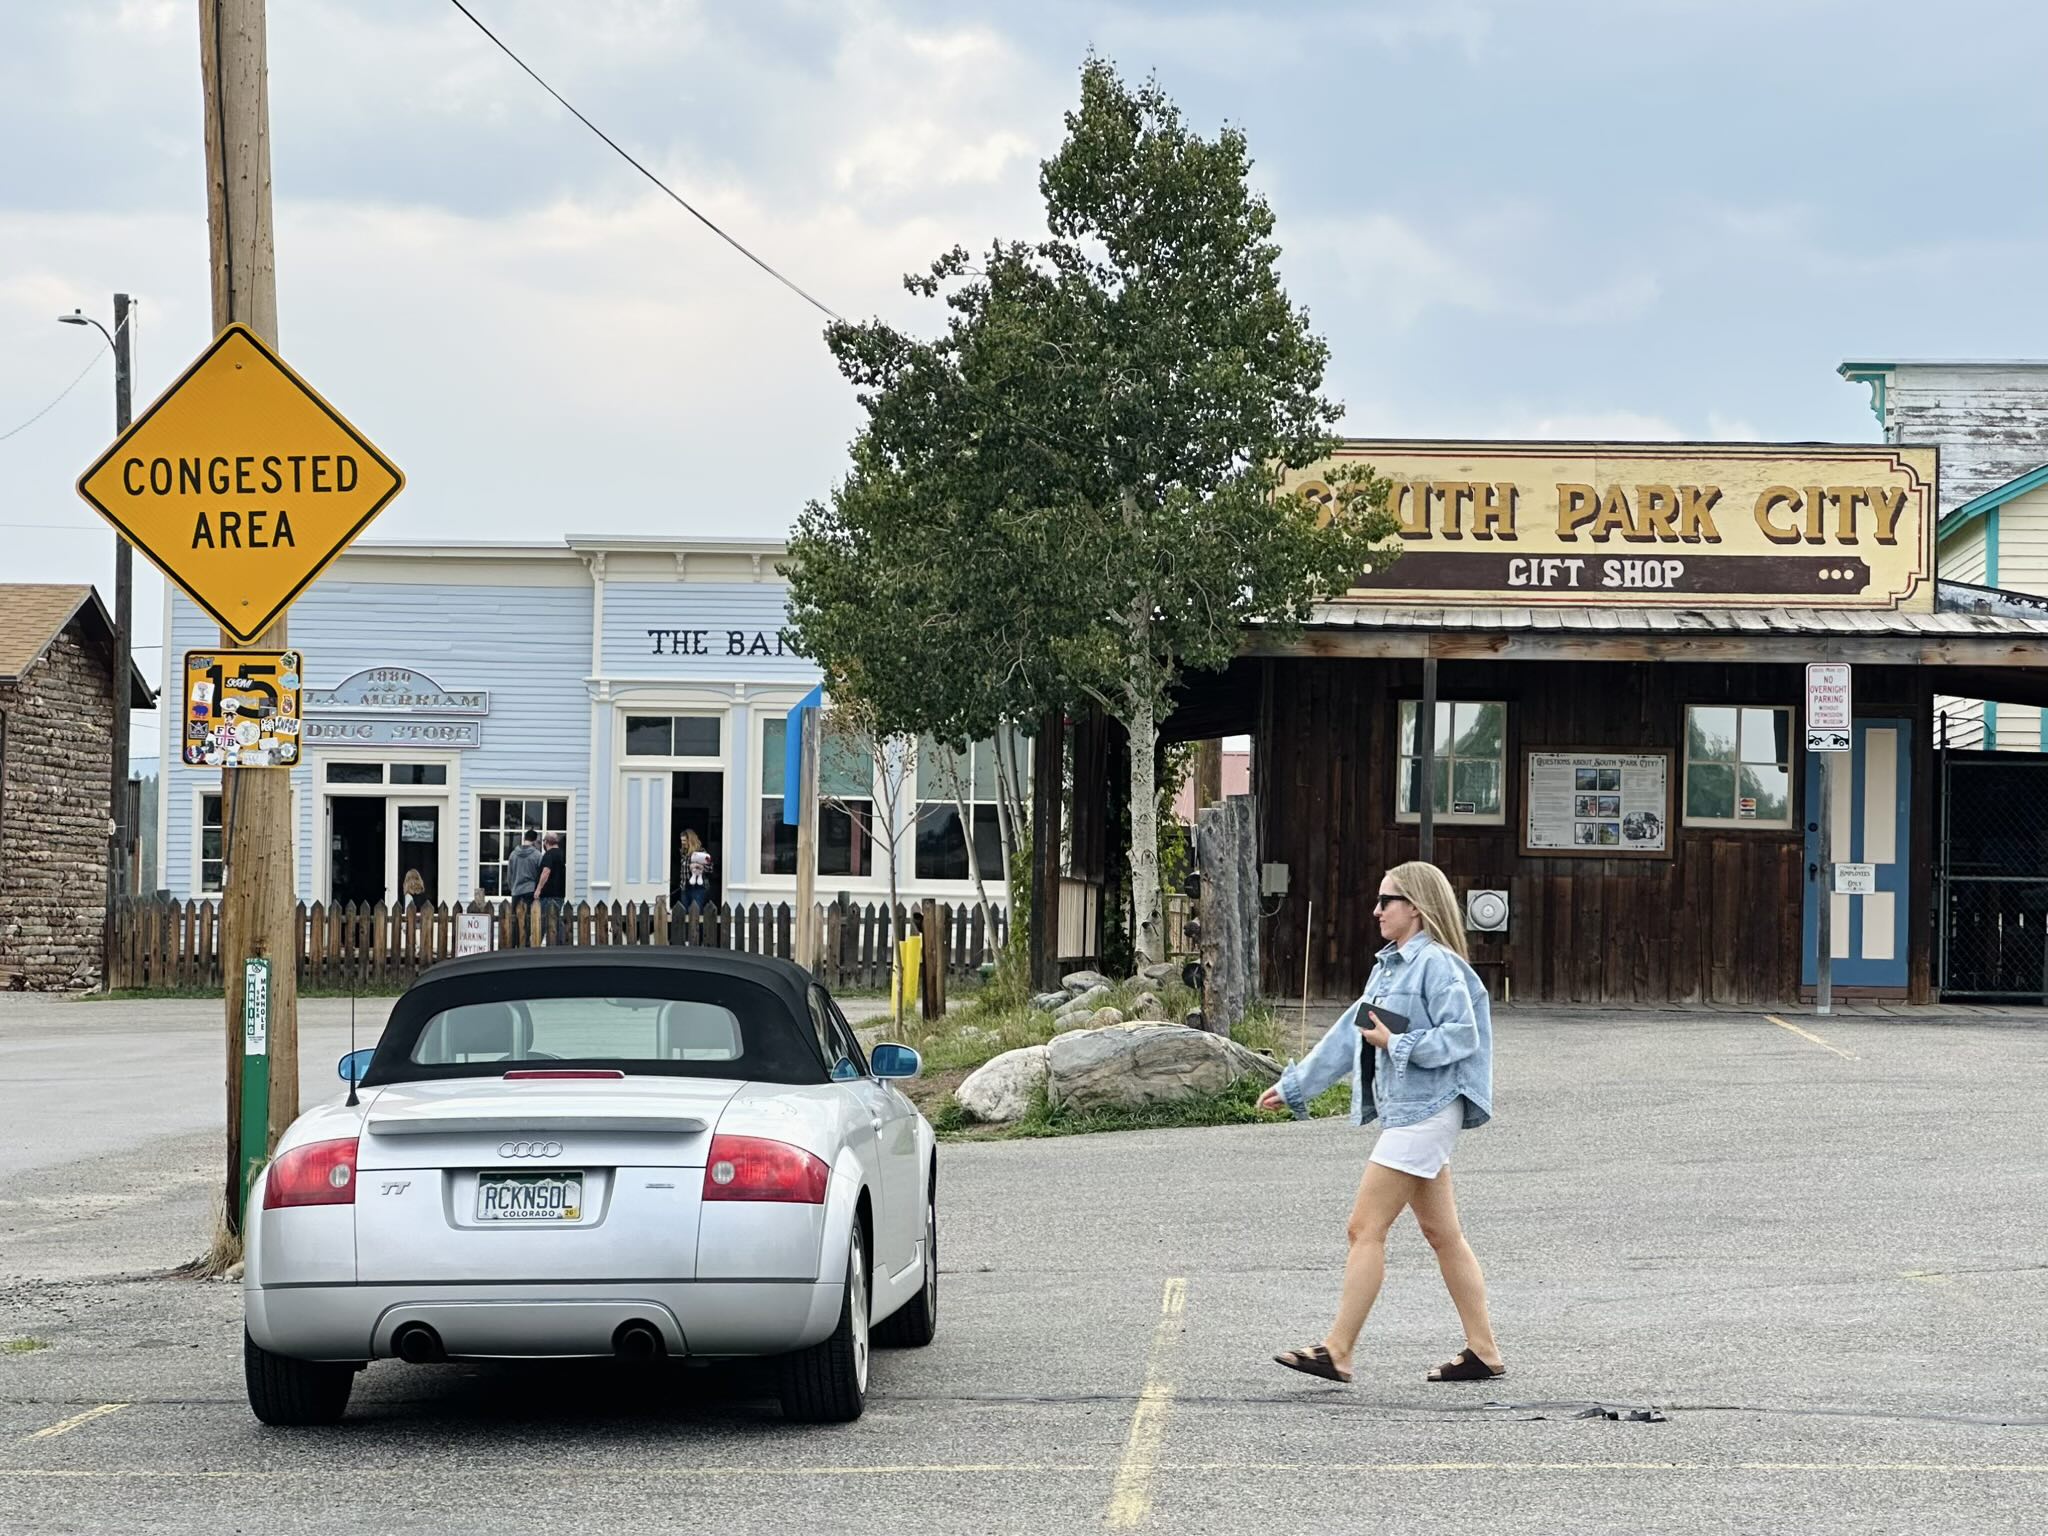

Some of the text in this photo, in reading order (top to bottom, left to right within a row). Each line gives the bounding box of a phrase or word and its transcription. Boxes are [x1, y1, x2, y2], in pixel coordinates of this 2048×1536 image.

[123, 455, 358, 496] CONGESTED
[1555, 483, 1723, 544] PARK
[1753, 486, 1907, 545] CITY
[191, 510, 296, 550] AREA
[1507, 558, 1685, 588] GIFT SHOP
[647, 630, 801, 656] THE BAN
[367, 670, 412, 684] 1880
[1823, 675, 1834, 684] NO
[205, 664, 278, 719] 15
[1809, 685, 1847, 694] OVERNIGHT
[1813, 695, 1844, 704] PARKING
[306, 724, 374, 739] DRUG
[391, 726, 472, 742] STORE
[467, 920, 480, 929] NO
[381, 1181, 411, 1195] TT
[485, 1185, 573, 1210] RCKNSOL
[502, 1210, 555, 1218] COLORADO
